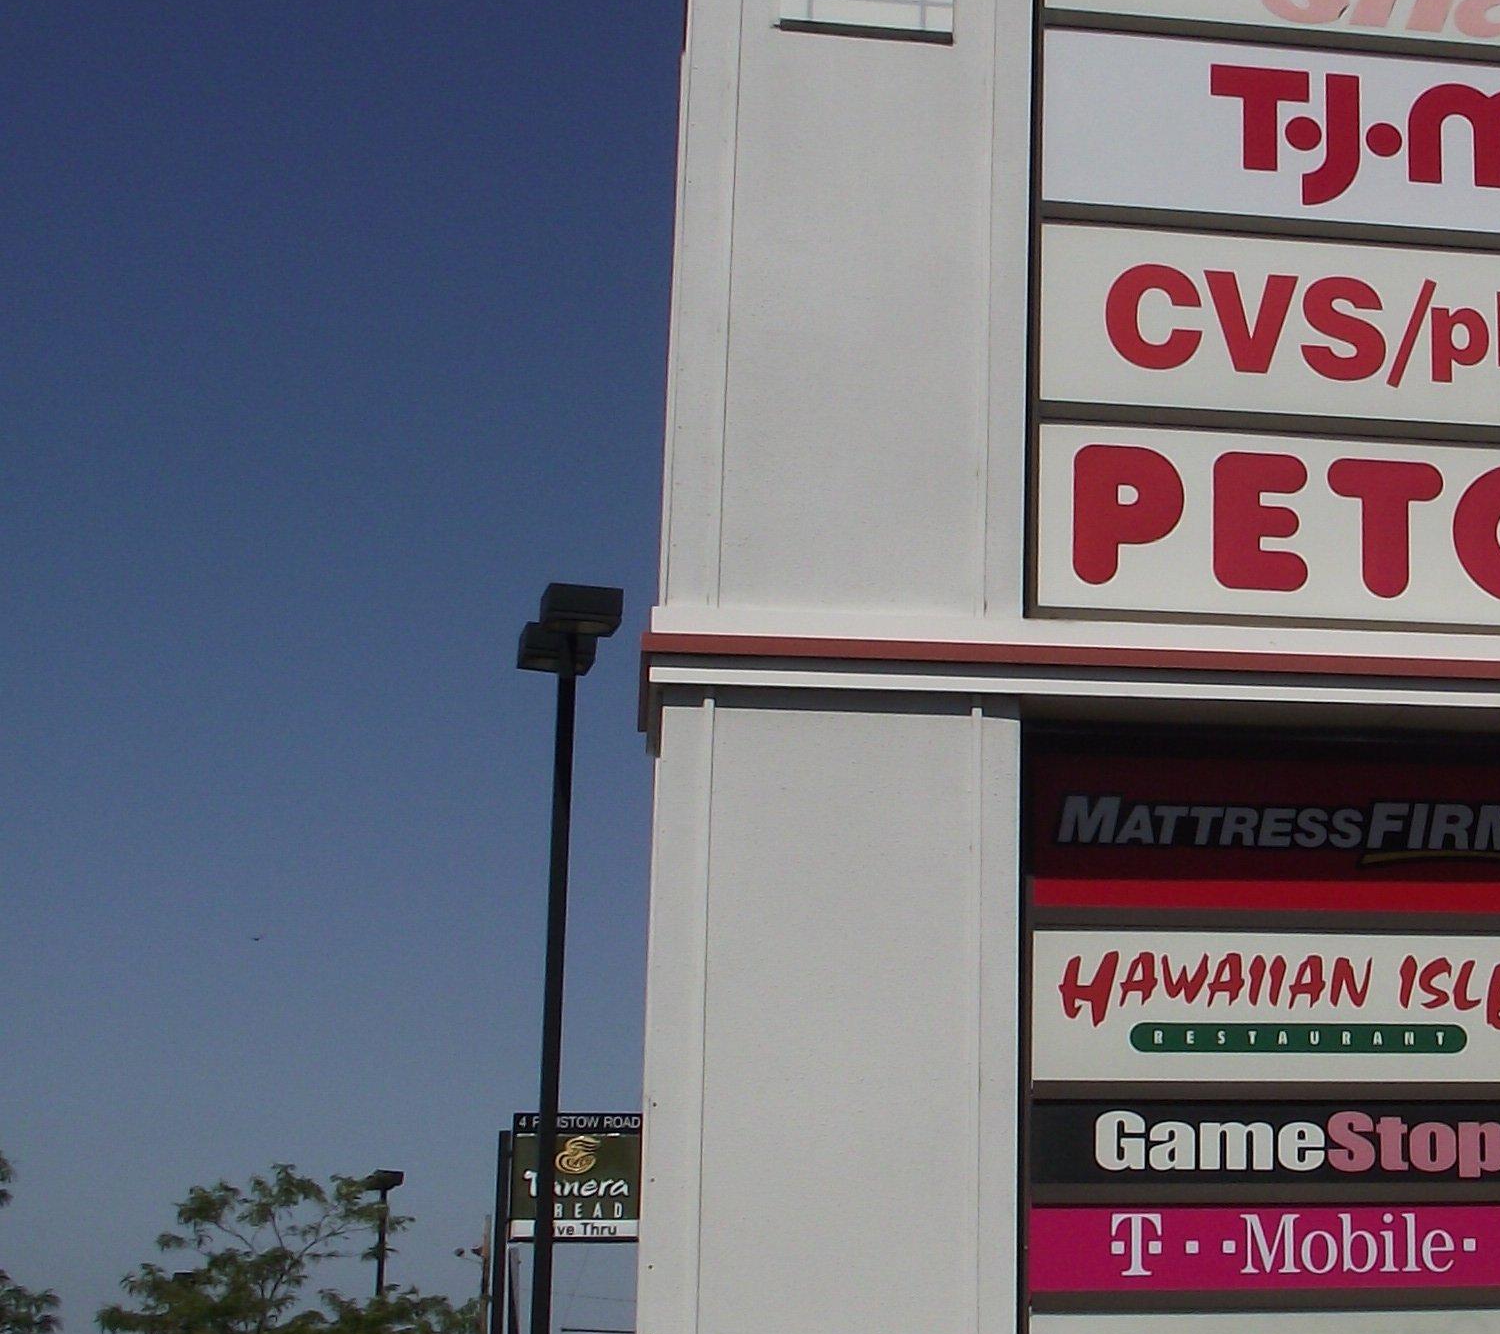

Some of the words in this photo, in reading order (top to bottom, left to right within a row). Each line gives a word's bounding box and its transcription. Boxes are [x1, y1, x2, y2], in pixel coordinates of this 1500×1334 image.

[1057, 950, 1374, 1027] HAWAIIAN
[1152, 1030, 1446, 1047] RESTAURANT
[519, 1117, 526, 1127] 4
[533, 1116, 598, 1128] PISTOW
[604, 1116, 640, 1128] ROAD
[554, 1203, 623, 1218] READ
[581, 1223, 616, 1235] Thru
